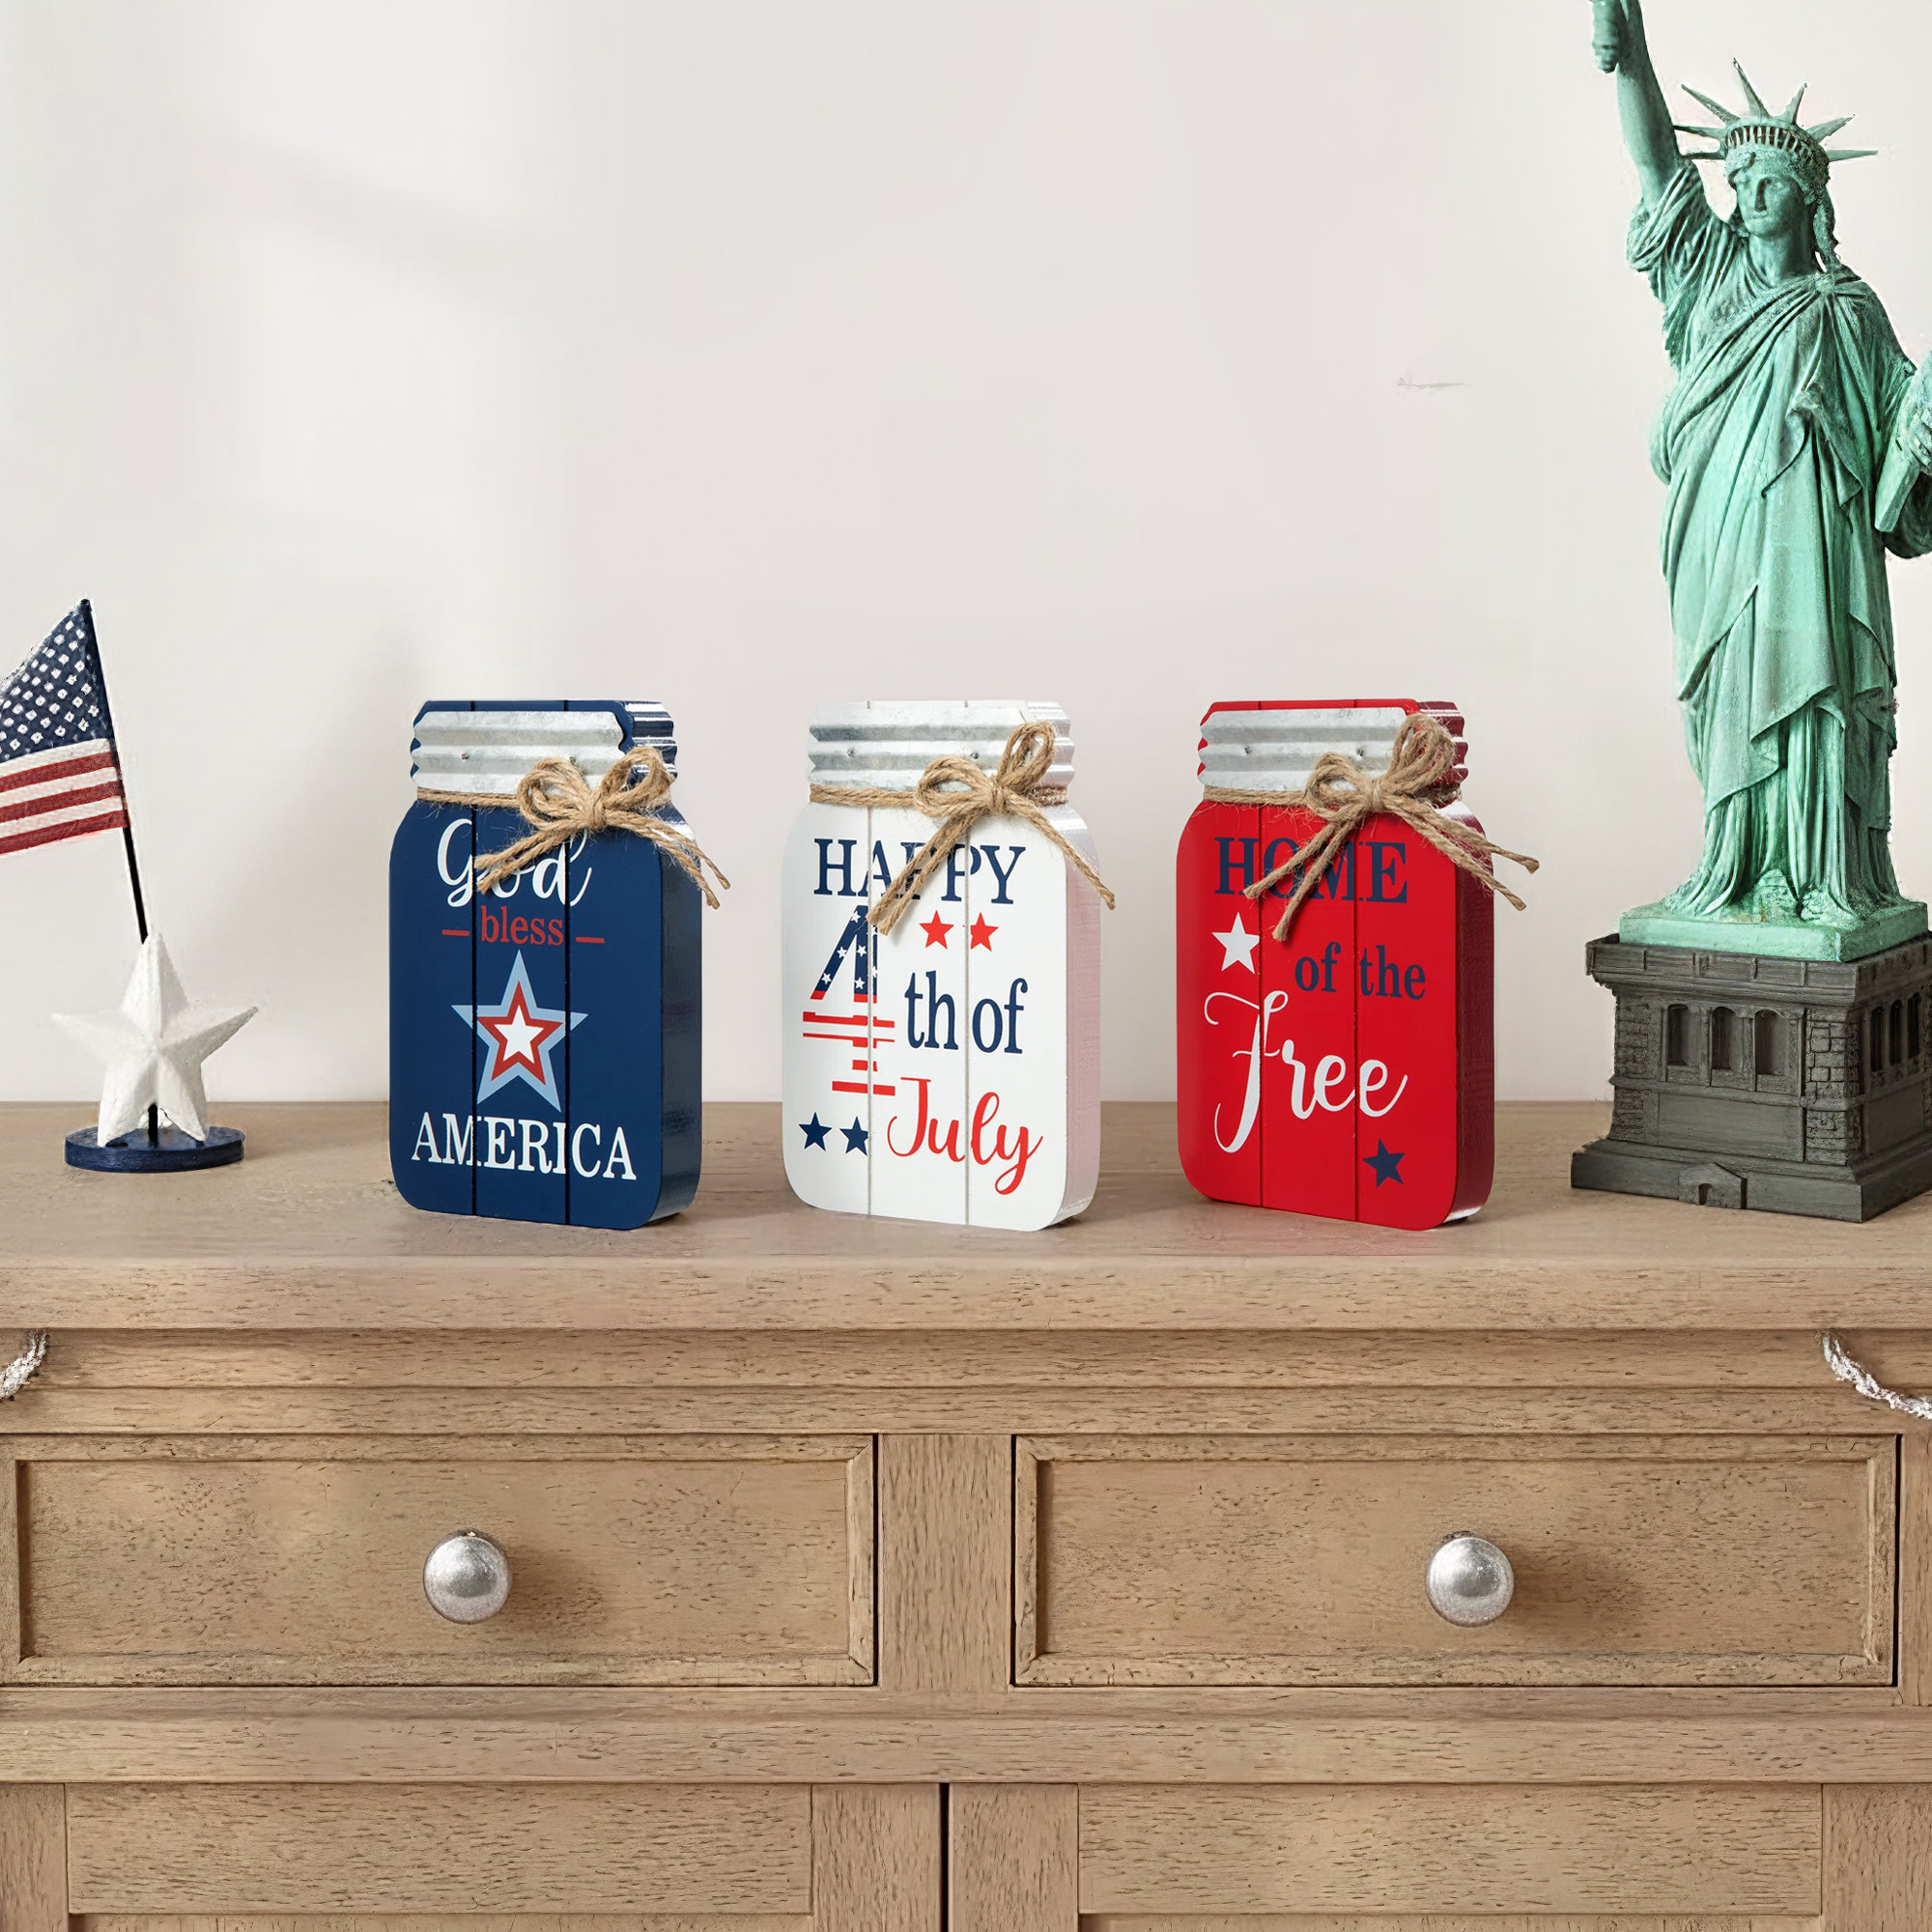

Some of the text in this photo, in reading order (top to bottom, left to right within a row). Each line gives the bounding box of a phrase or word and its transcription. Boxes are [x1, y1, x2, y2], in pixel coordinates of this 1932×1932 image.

[438, 818, 592, 907] God
[1214, 837, 1407, 903] HOME
[481, 905, 563, 946] bless
[1294, 942, 1426, 1001] of the
[972, 978, 1029, 1055] of
[1204, 990, 1408, 1153] Free
[411, 1111, 638, 1180] AMERICA
[886, 1076, 1044, 1196] July
